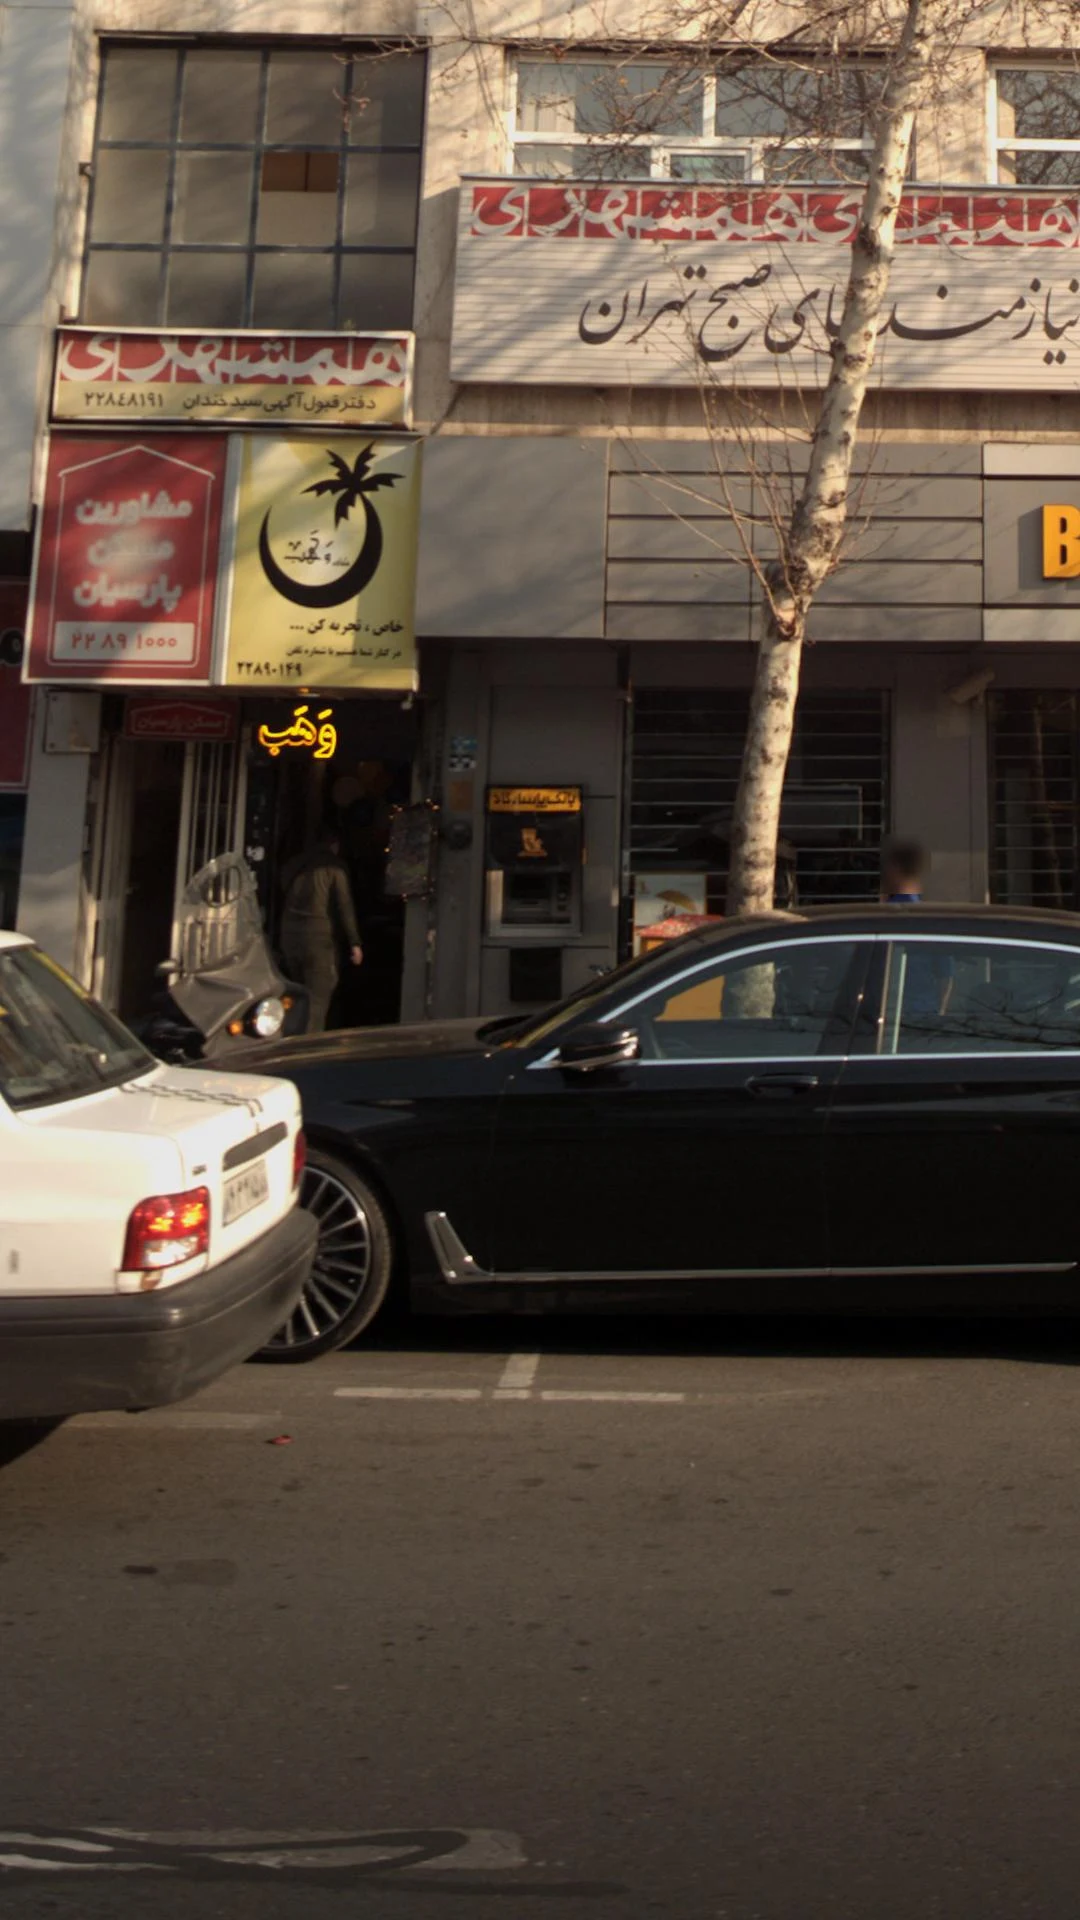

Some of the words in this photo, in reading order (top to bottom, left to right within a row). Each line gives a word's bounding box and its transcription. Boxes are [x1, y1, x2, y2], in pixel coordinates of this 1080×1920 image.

[472, 186, 802, 243] همشهری
[579, 264, 707, 345] تهران
[698, 263, 772, 362] صبح
[60, 335, 406, 386] همشهری
[183, 393, 230, 410] خندان
[230, 396, 262, 410] سید
[264, 391, 304, 412] آگهی
[303, 396, 341, 413] قبول
[340, 394, 377, 411] دفتر
[75, 489, 193, 525] مشاورین
[73, 573, 183, 613] پارسیان
